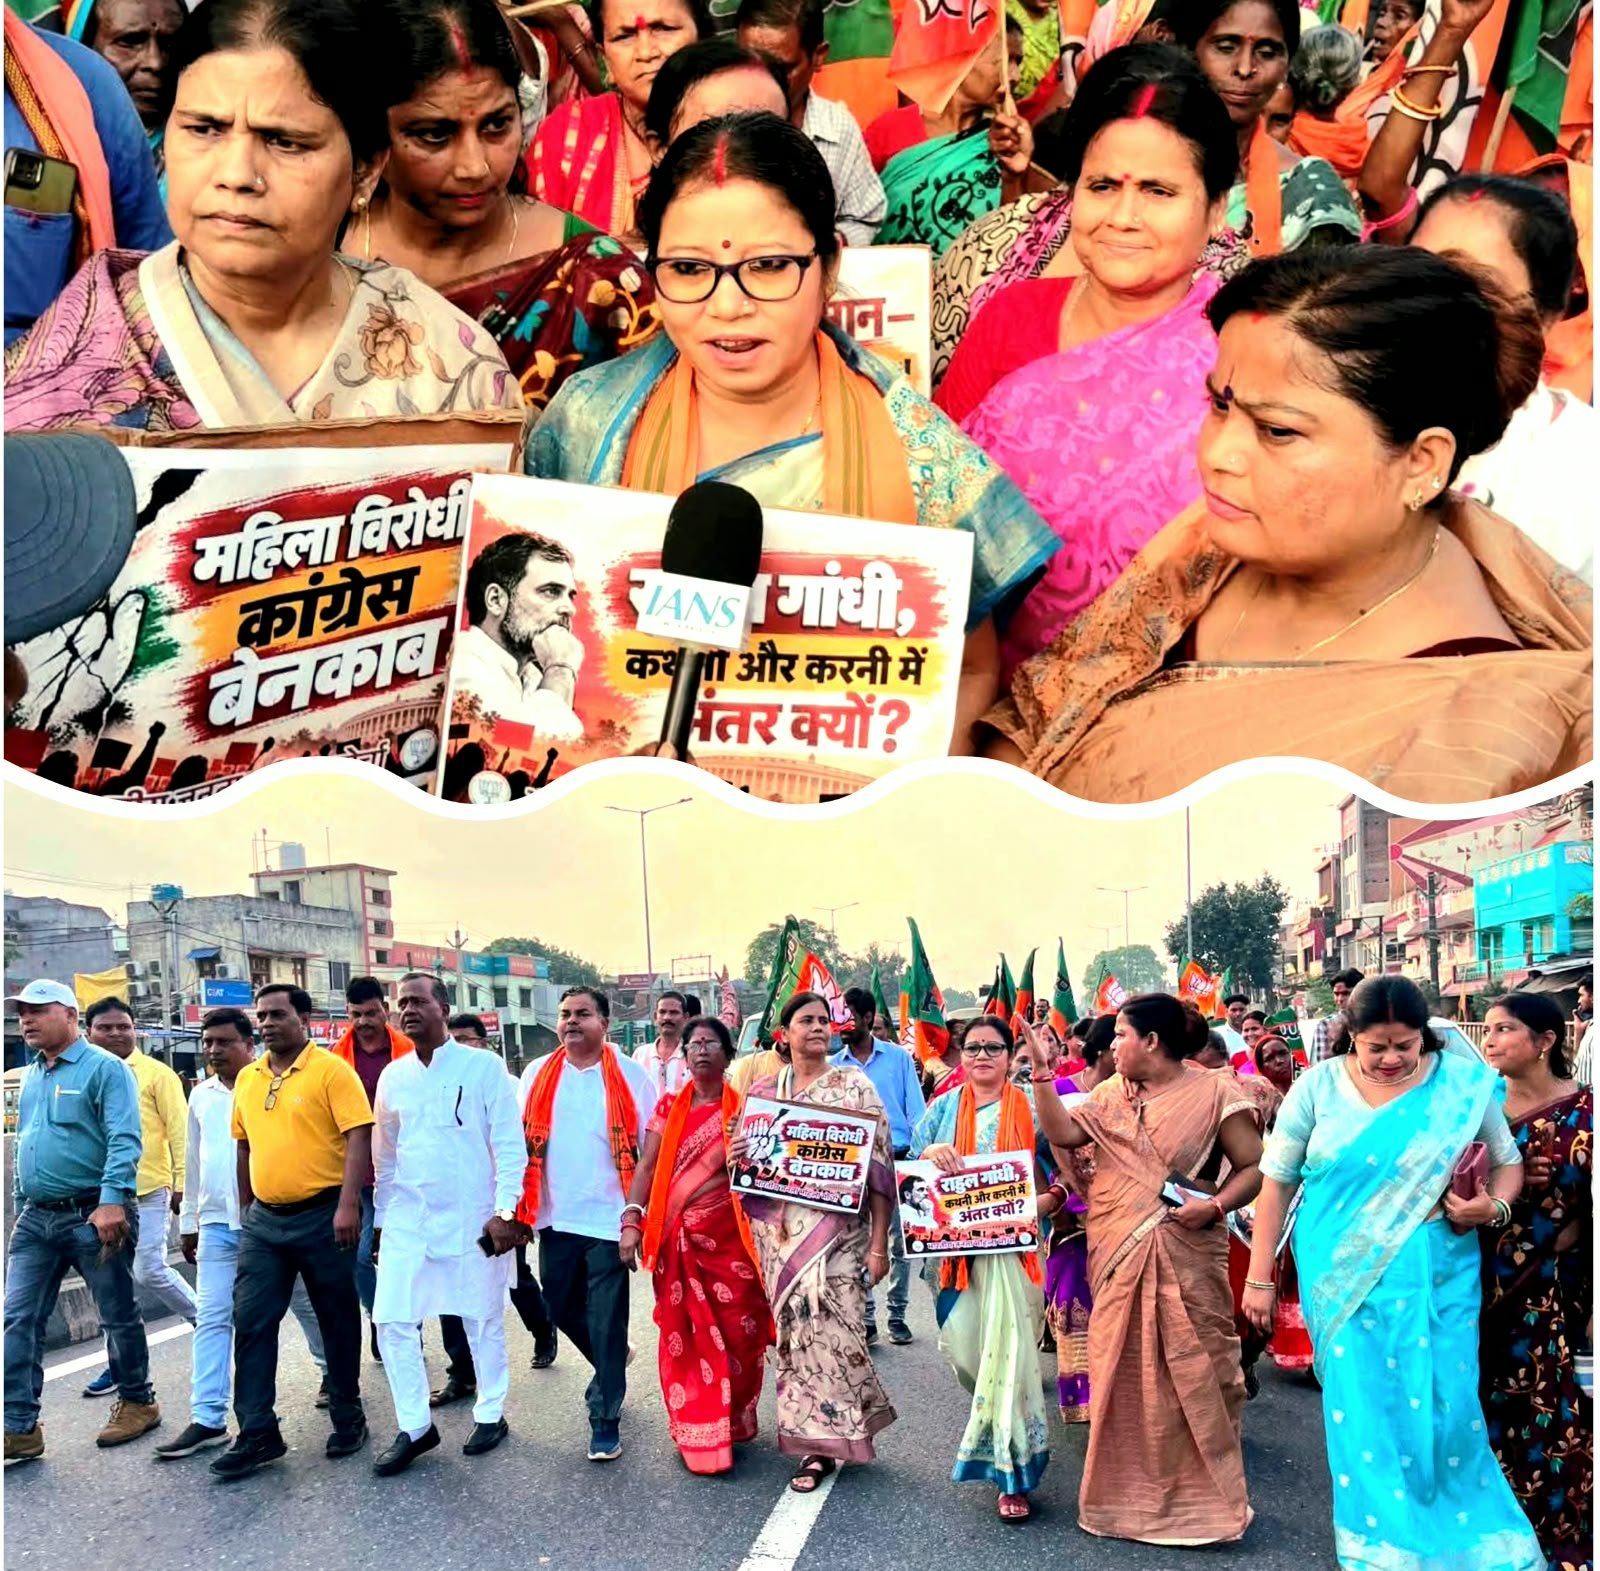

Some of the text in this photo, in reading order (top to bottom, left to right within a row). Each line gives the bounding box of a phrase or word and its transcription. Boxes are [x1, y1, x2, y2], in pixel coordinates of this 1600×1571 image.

[193, 479, 472, 584] महिला विरोधी
[237, 567, 421, 648] कांग्रेस
[646, 585, 741, 628] IANS
[777, 560, 917, 637] गांधी,
[208, 616, 448, 727] बेनकाब
[736, 640, 799, 683] और
[805, 645, 892, 685] करनी
[899, 646, 928, 686] में
[791, 690, 911, 753] क्यों?
[786, 1123, 865, 1145] महिला विरोधी
[797, 1142, 848, 1161] कांग्रेस
[789, 1157, 857, 1180] बेनकाब
[940, 1173, 980, 1194] राहुल
[944, 1183, 1026, 1208] कथनी और करनी में
[959, 1199, 1025, 1223] अंतर क्यों?
